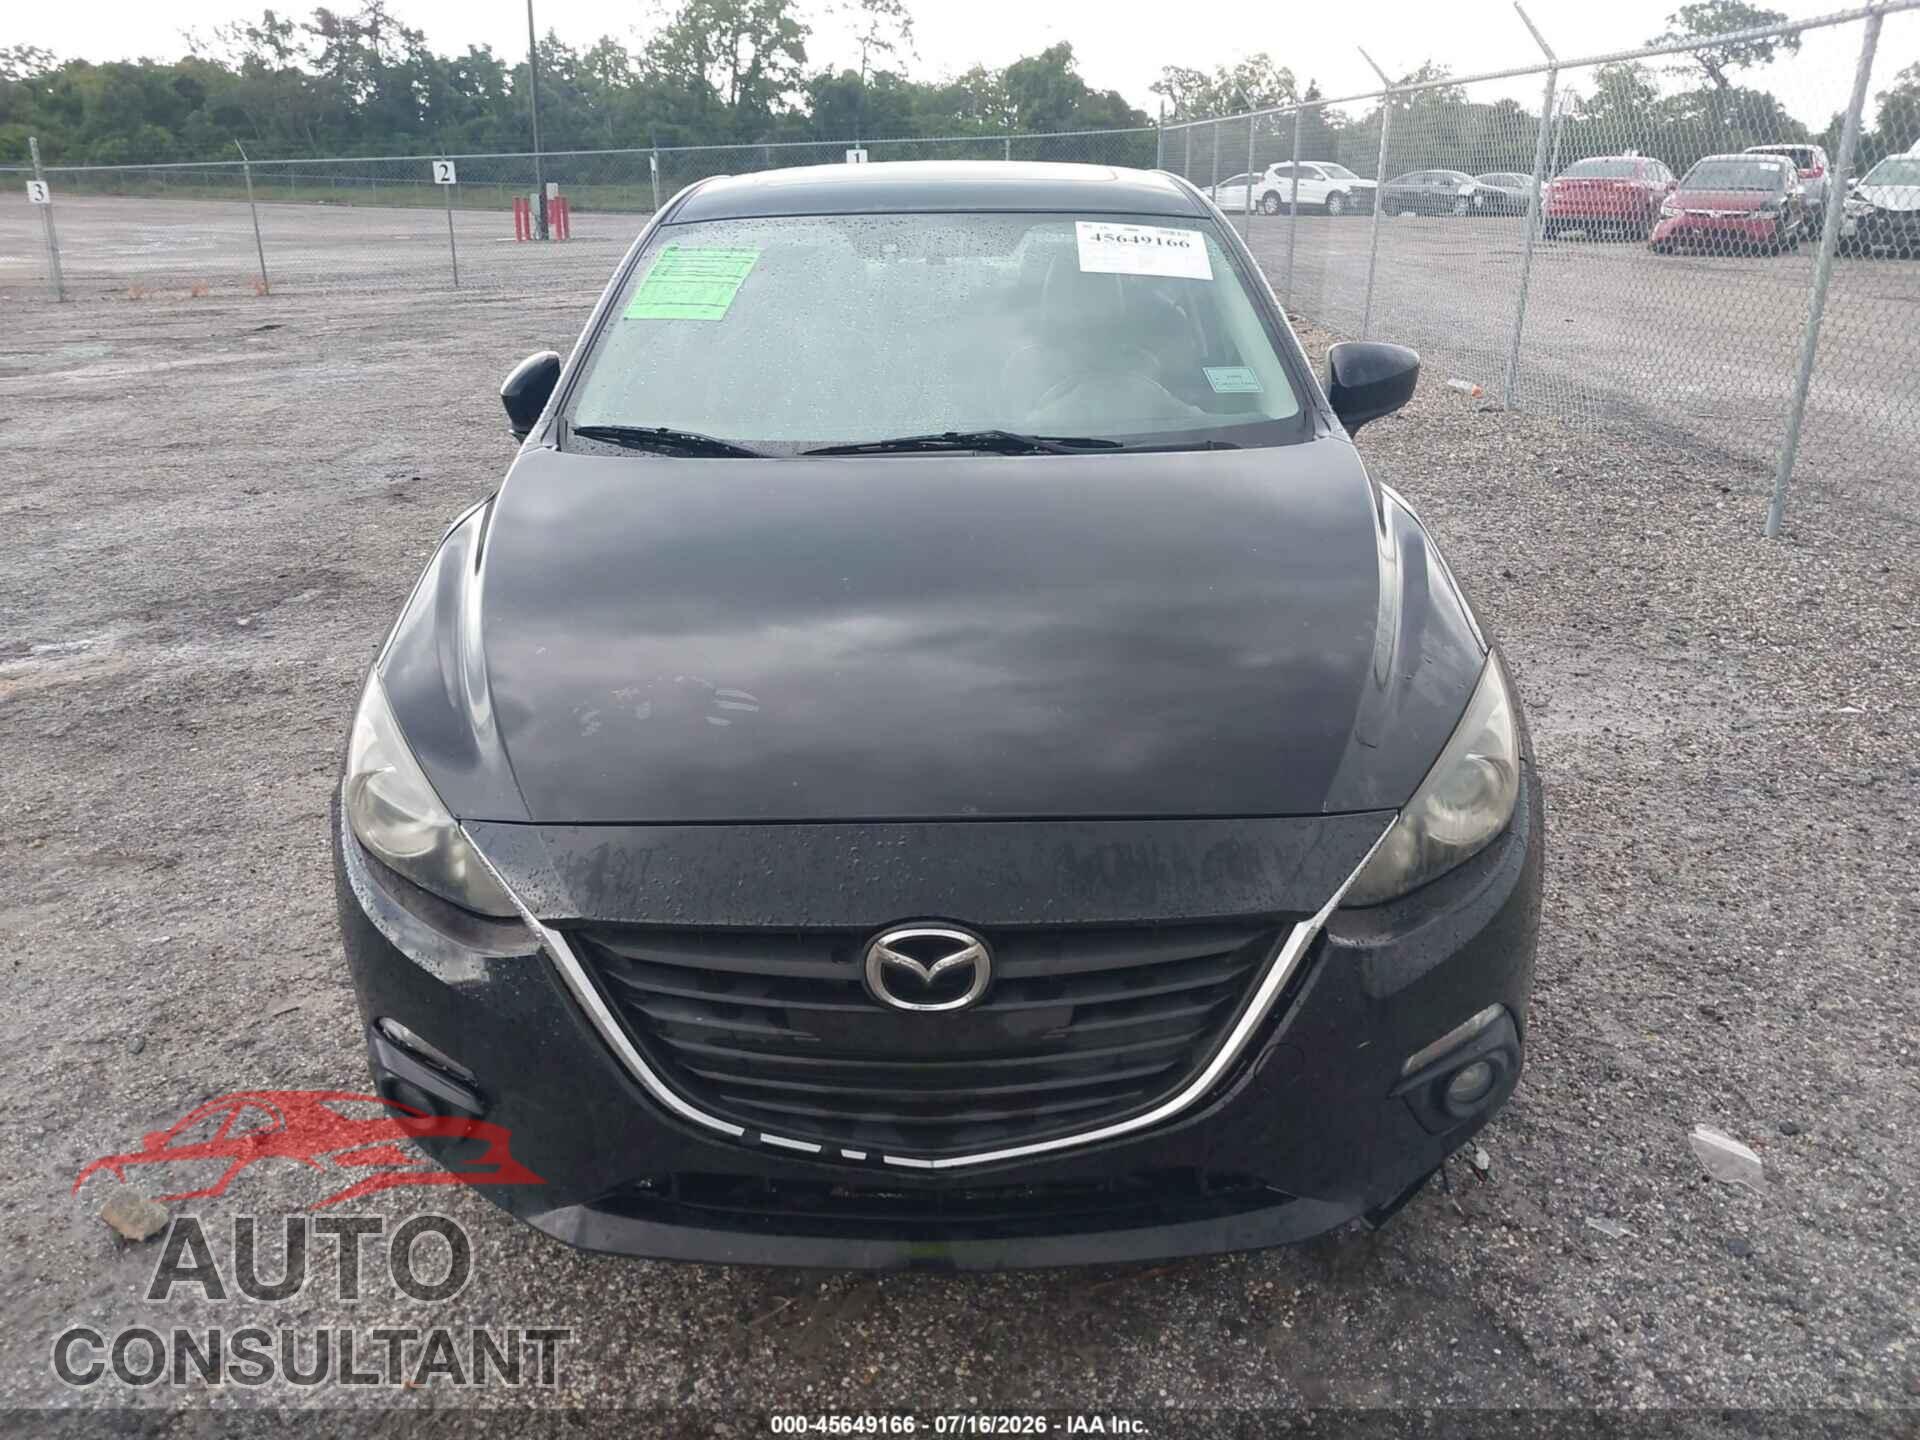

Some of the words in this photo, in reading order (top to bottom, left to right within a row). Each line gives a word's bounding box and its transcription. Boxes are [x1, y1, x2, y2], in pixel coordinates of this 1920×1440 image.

[439, 164, 450, 182] 2
[34, 183, 45, 202] 3
[1090, 232, 1191, 249] 45649166
